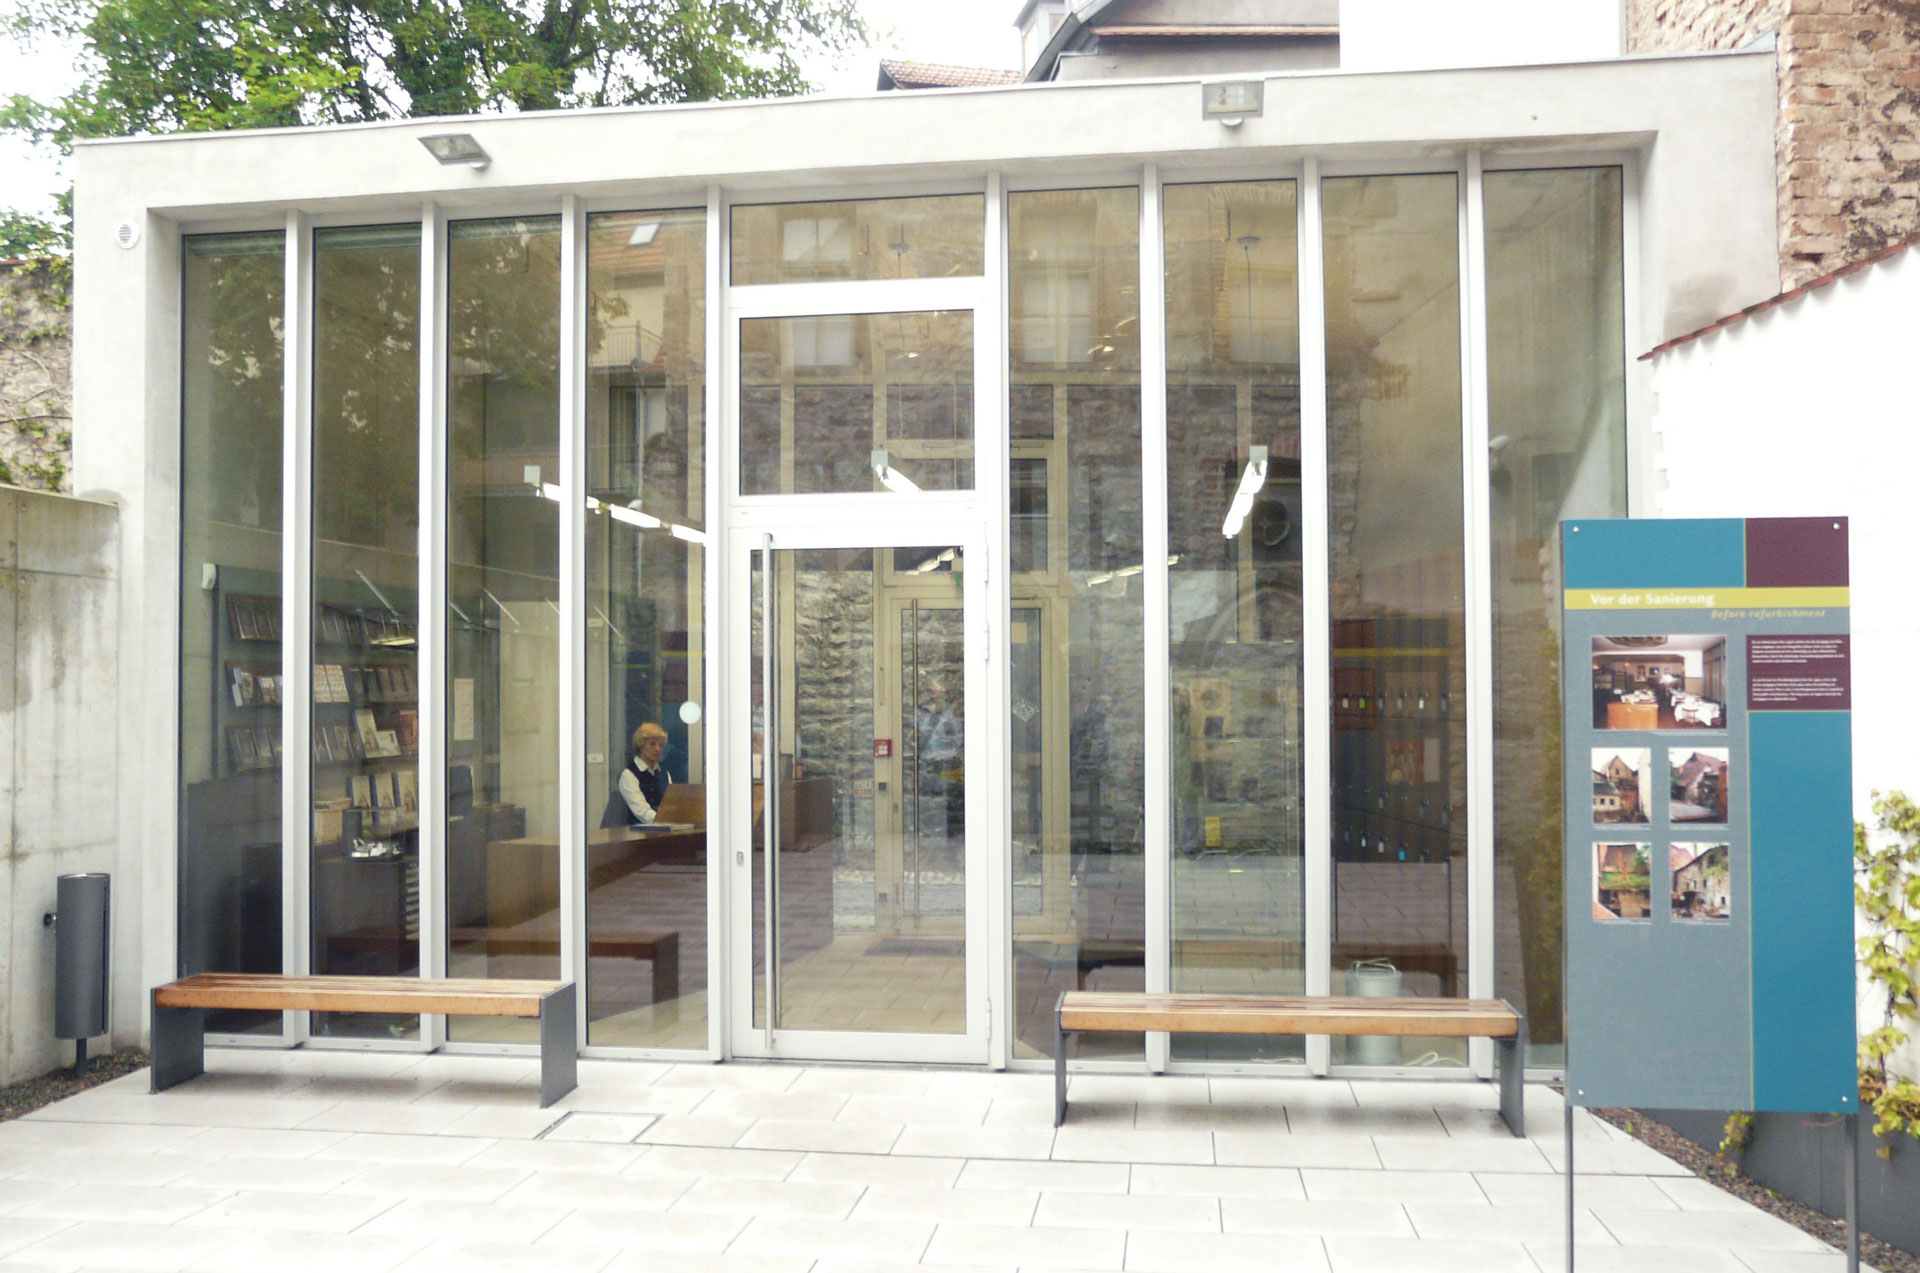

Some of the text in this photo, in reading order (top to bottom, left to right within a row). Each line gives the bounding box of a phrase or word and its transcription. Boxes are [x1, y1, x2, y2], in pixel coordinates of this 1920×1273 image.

[1590, 593, 1714, 607] Vor der Sanierung
[1711, 609, 1826, 620] Before refurbishment
